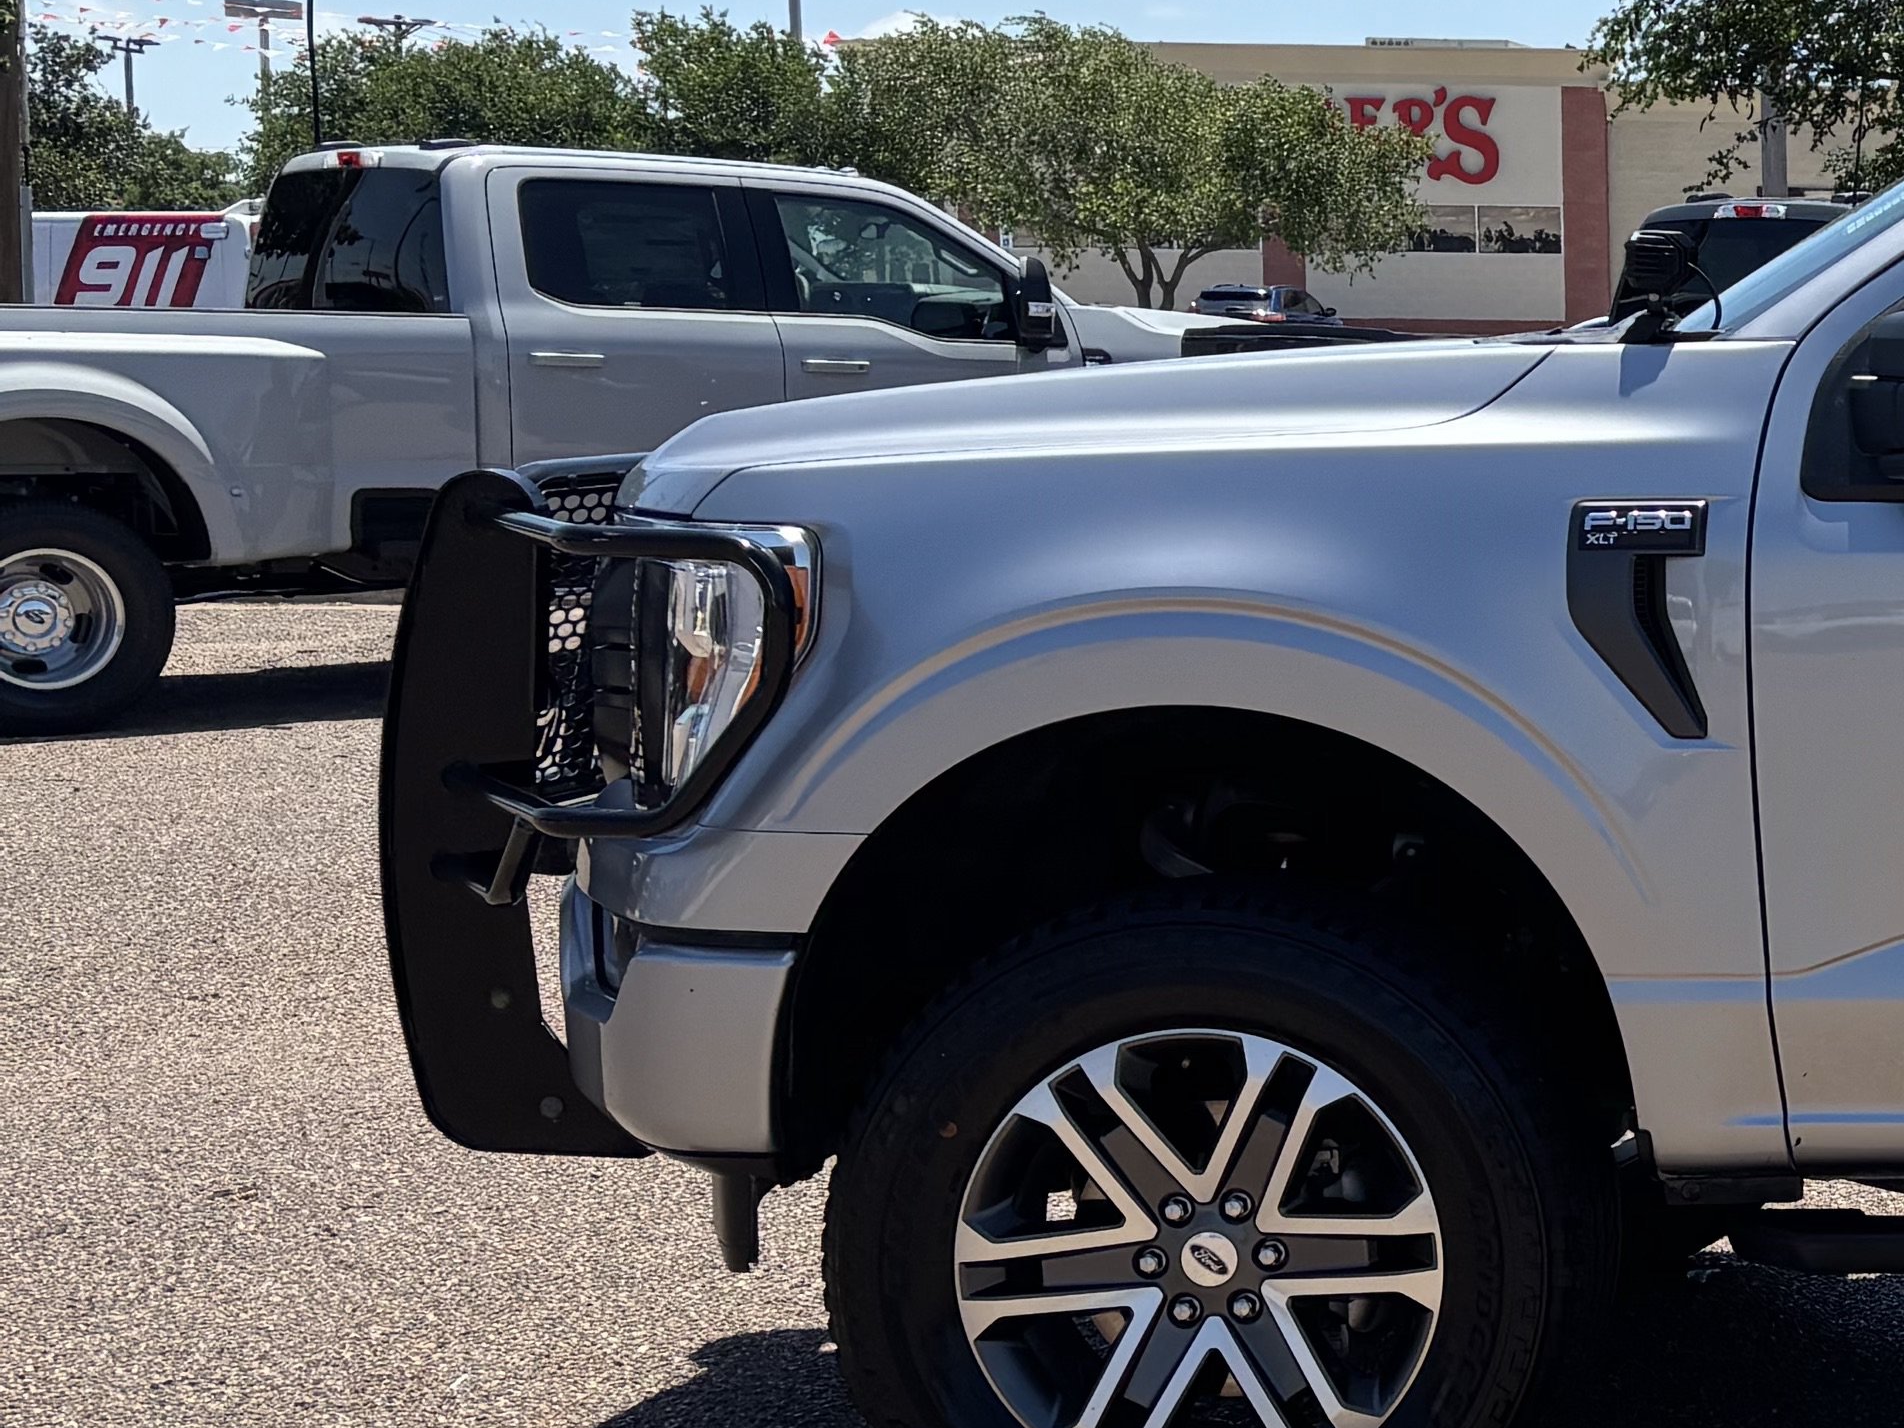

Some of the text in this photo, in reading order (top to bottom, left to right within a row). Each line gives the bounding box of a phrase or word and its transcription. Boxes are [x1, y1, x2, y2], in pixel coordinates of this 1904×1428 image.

[1327, 86, 1500, 185] ER'S
[93, 222, 200, 238] EMERGENCY
[74, 245, 189, 307] 911
[1583, 509, 1694, 531] F-150
[1585, 531, 1618, 545] XLT
